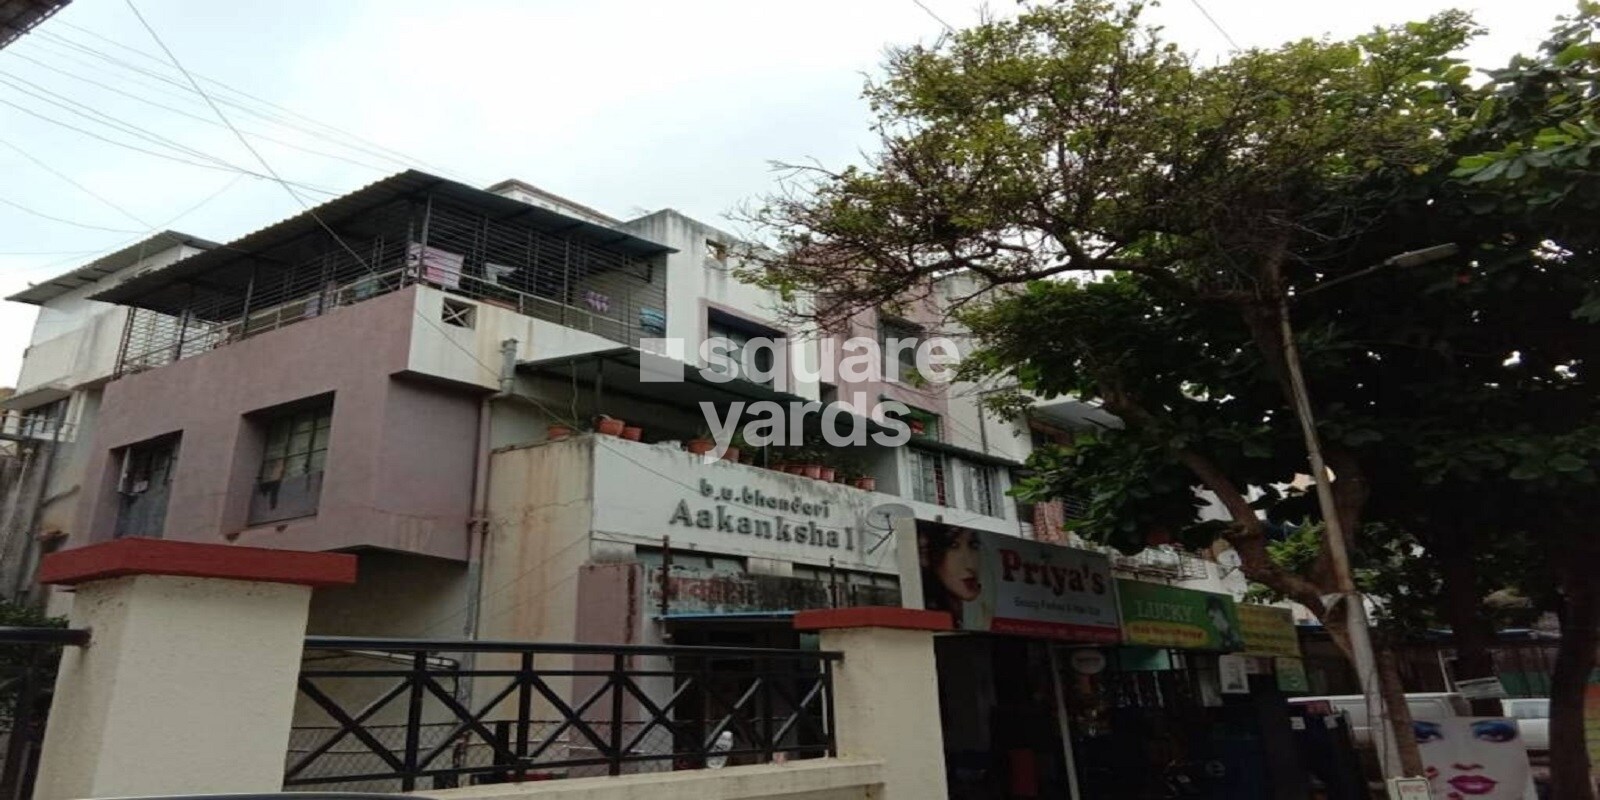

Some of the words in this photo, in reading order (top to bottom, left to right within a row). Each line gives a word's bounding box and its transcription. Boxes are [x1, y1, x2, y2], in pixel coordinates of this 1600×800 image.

[669, 498, 839, 548] Aakanksha
[999, 548, 1105, 596] Priya's
[1135, 600, 1195, 623] LUCKY
